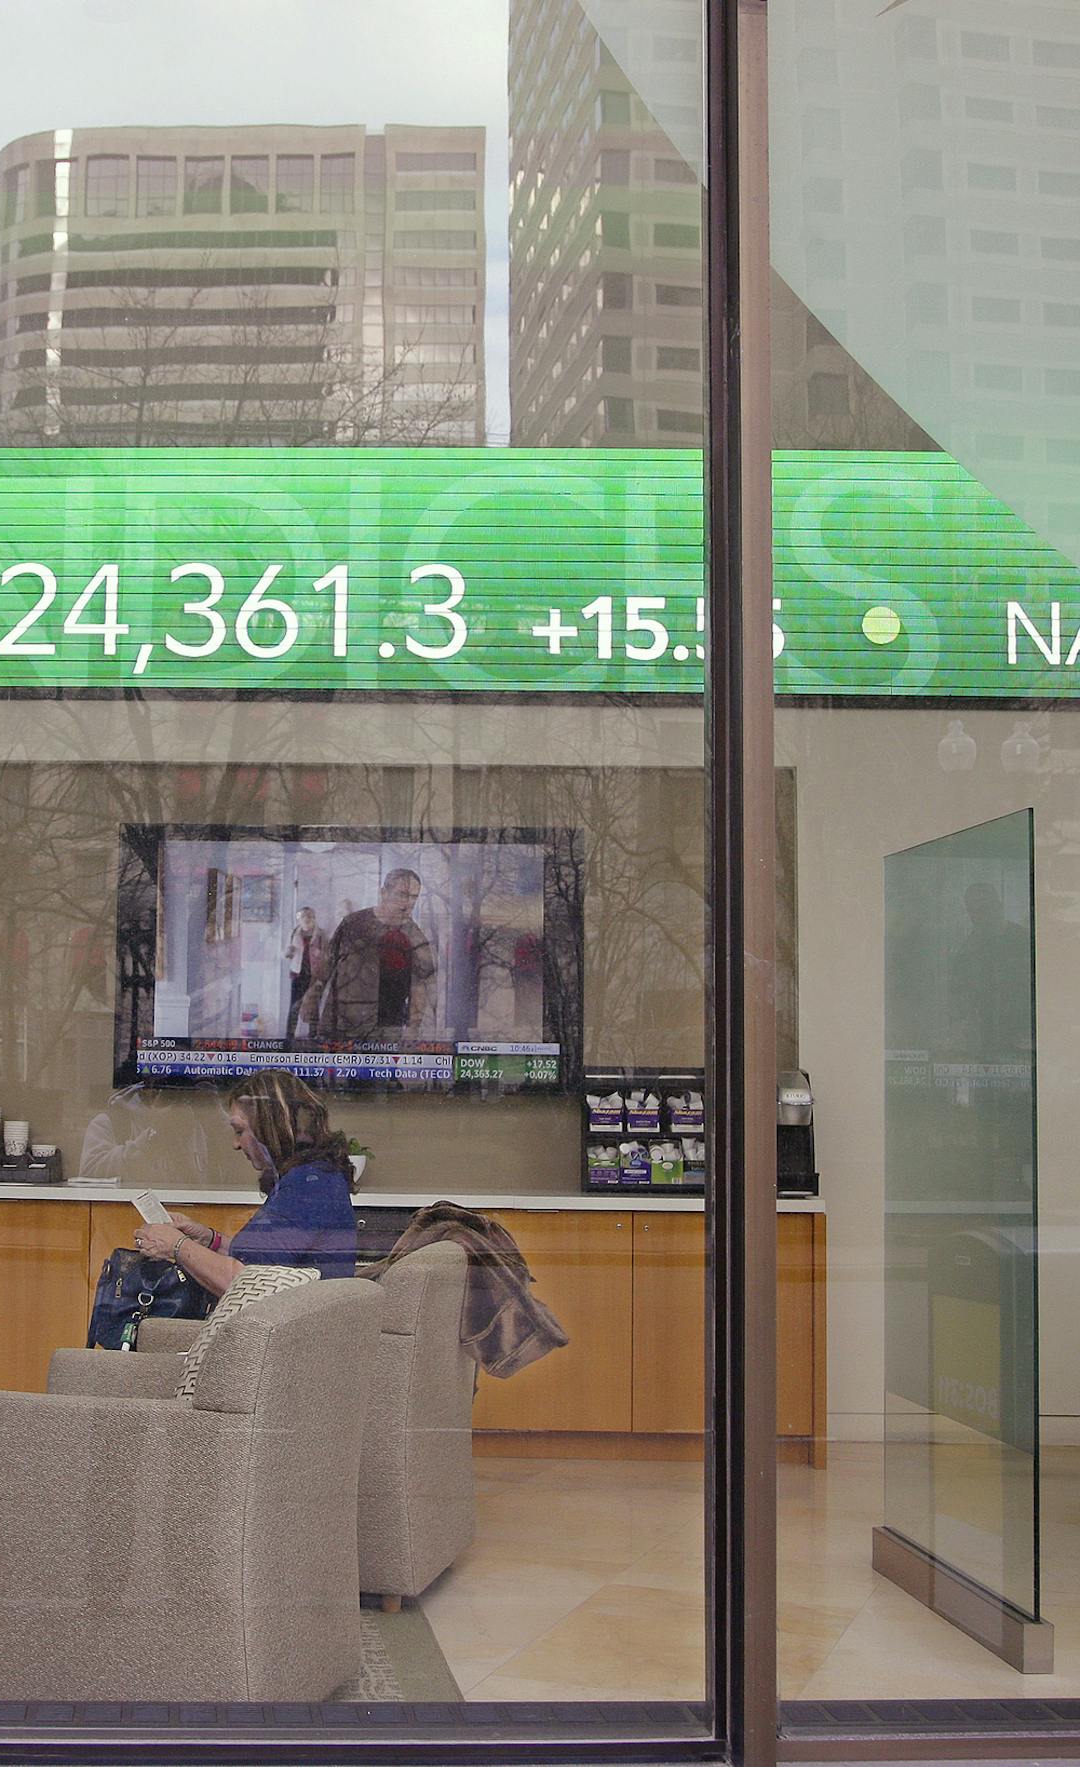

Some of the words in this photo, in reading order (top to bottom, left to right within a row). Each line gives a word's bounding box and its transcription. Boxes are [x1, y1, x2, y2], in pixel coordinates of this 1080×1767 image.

[1006, 600, 1080, 666] N
[160, 1039, 176, 1048] 500
[247, 1040, 284, 1050] CHANGE
[250, 1053, 291, 1064] Emerson
[294, 1054, 329, 1064] Electric
[332, 1054, 362, 1066] (EMR)
[460, 1058, 485, 1068] DOW
[526, 1060, 557, 1069] +17.52
[151, 1065, 172, 1075] 6.76
[184, 1065, 233, 1076] Automatic
[294, 1067, 325, 1078] 111.37
[336, 1068, 357, 1078] 2.70
[369, 1069, 392, 1079] Tech
[394, 1069, 418, 1079] Data
[420, 1069, 451, 1080] (TECD
[524, 1070, 557, 1080] +0.07%
